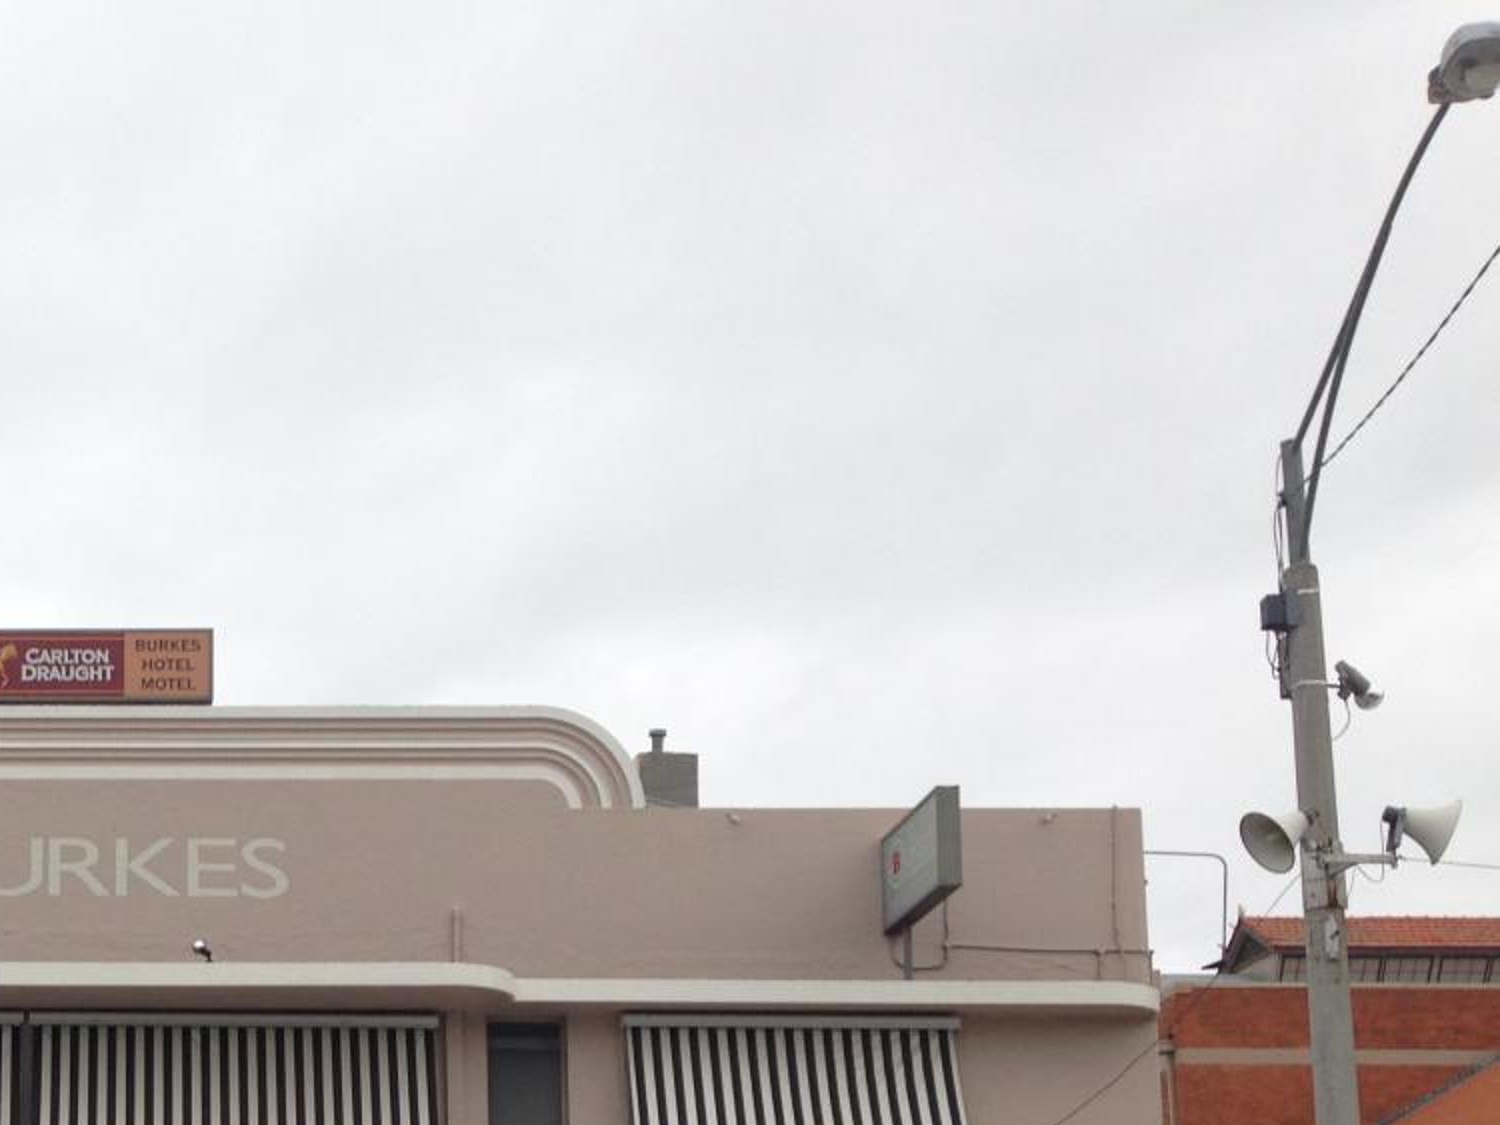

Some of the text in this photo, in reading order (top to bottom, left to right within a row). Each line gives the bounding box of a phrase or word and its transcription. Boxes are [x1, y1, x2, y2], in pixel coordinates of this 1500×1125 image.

[134, 639, 202, 652] BURKES
[25, 647, 110, 664] CARLTON
[141, 657, 197, 672] HOTEL
[20, 664, 115, 683] DRAUGHT
[140, 676, 198, 691] MOTEL
